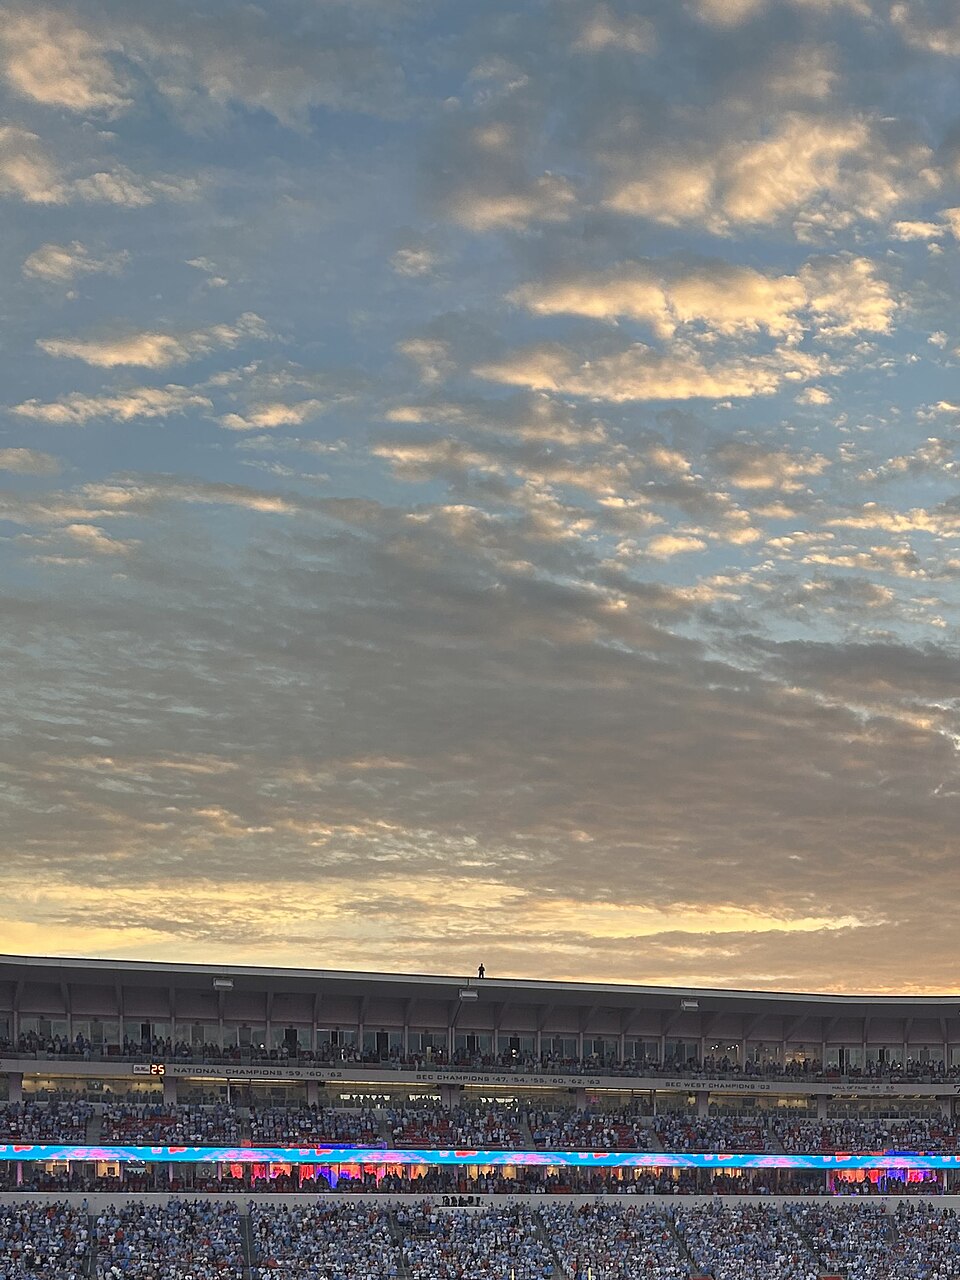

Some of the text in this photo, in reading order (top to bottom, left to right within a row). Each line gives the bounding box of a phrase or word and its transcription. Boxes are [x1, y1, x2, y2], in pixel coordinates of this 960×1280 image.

[151, 1064, 165, 1075] 25
[173, 1067, 223, 1075] NATIONAL
[225, 1068, 282, 1076] CHAMPIONS
[436, 1074, 490, 1082] CHAMPIONS
[708, 1082, 756, 1090] CHAMPIONS
